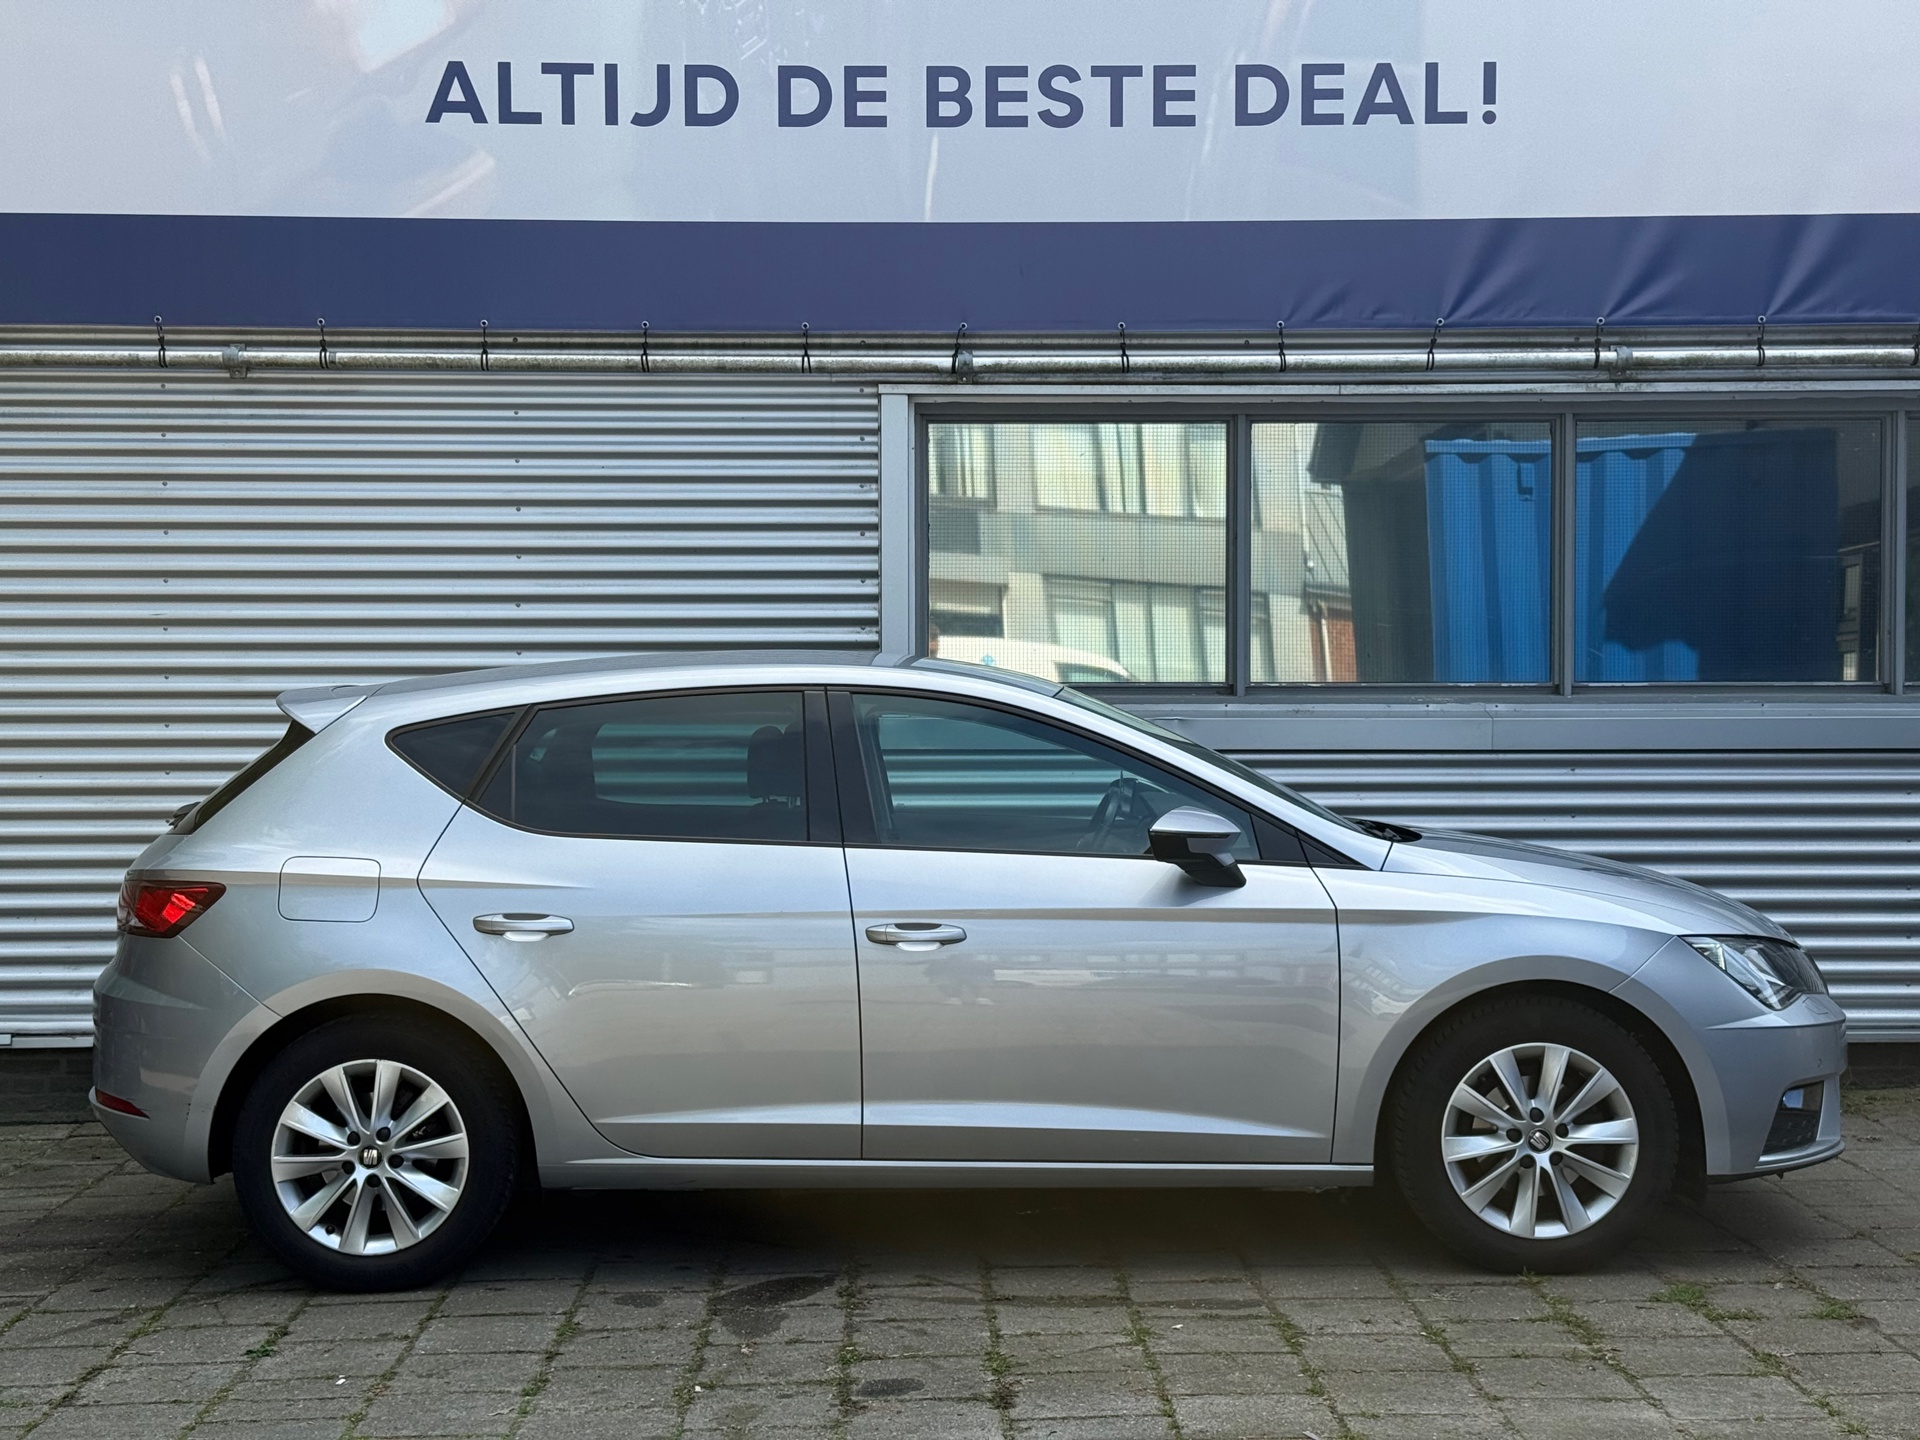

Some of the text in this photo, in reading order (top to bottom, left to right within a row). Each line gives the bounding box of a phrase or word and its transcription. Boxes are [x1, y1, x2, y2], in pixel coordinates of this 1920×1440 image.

[425, 61, 1496, 128] ALTIJD DE BESTE DEAL!
